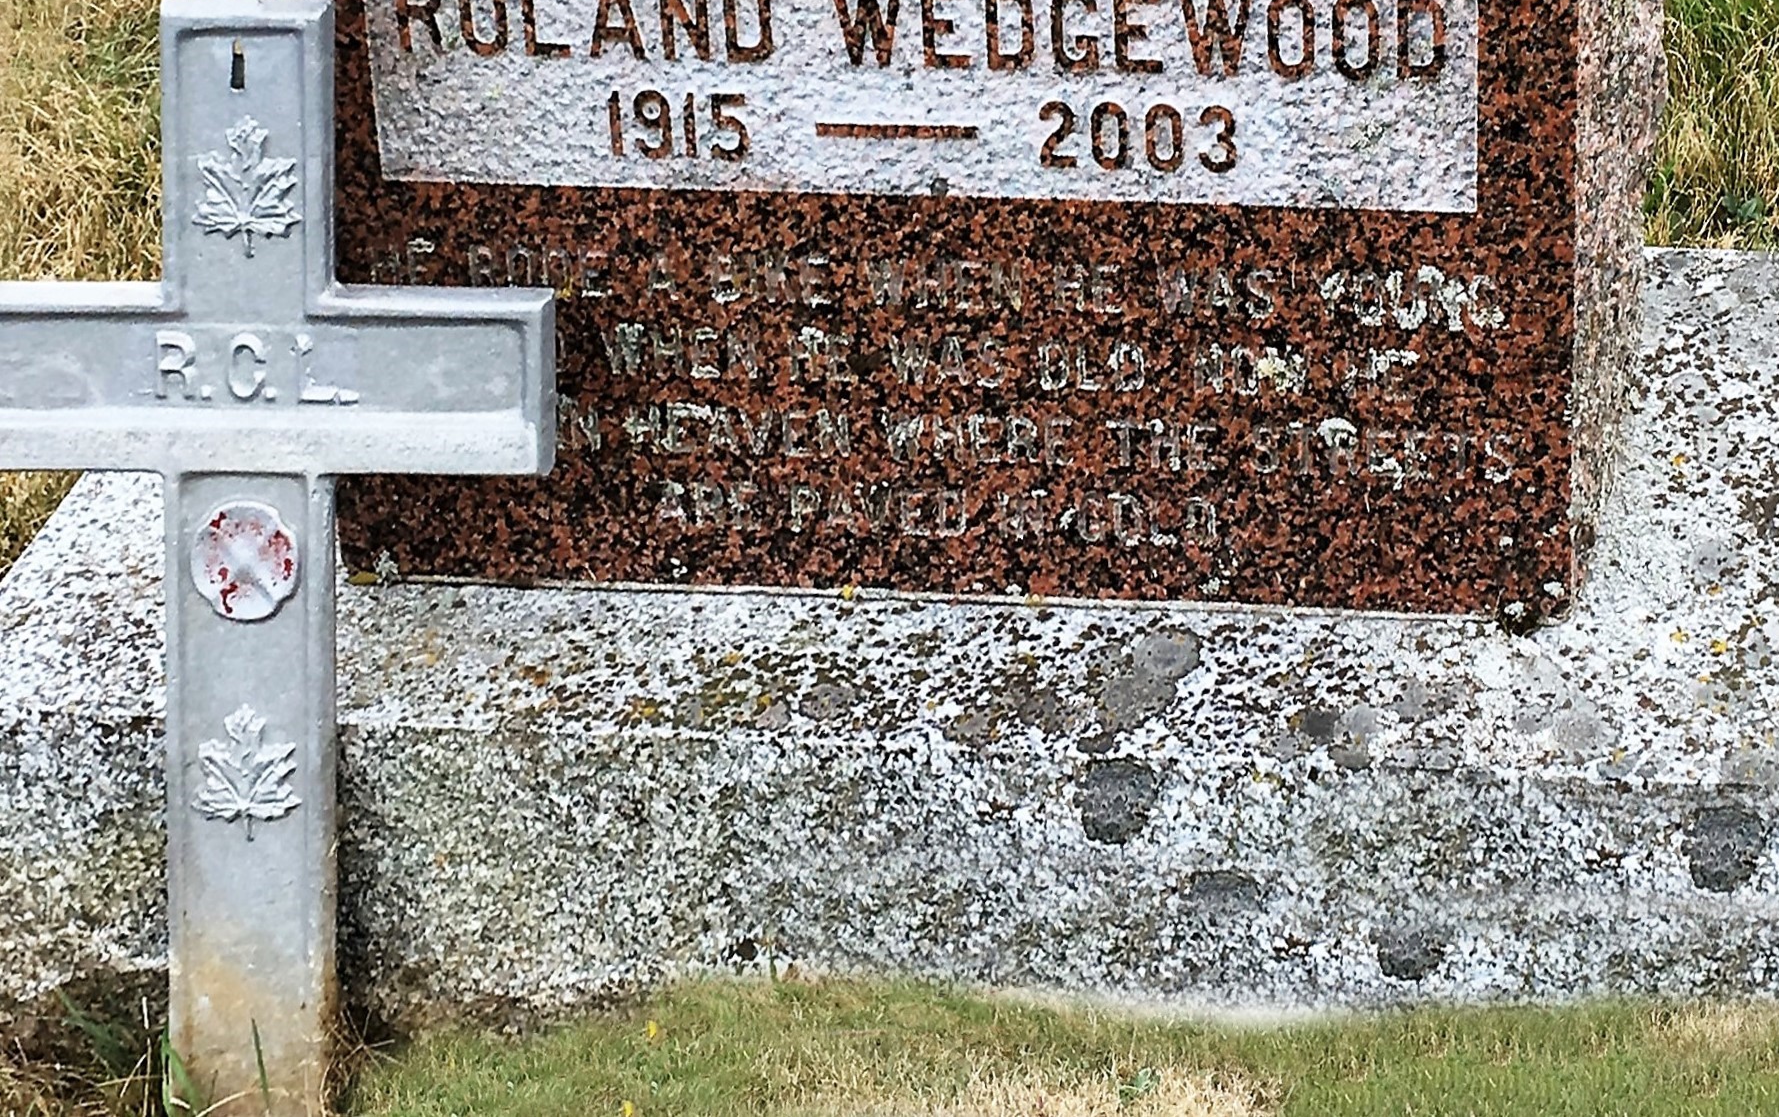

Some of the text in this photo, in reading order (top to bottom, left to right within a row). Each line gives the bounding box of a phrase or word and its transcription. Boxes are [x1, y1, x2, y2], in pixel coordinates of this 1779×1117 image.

[607, 88, 751, 163] 1915
[1038, 100, 1239, 175] 2003
[1052, 262, 1125, 315] HE
[1156, 265, 1276, 321] WAS
[1318, 264, 1506, 332] YOUNG
[600, 322, 760, 381] WHEN
[888, 336, 1008, 391] WAS
[1036, 340, 1149, 394] OLD
[624, 401, 852, 459] HEAVEN
[881, 410, 1076, 468] WHERE
[1105, 416, 1226, 473] THE
[1246, 416, 1516, 486] STREETS
[655, 477, 763, 532] ARE
[788, 481, 969, 539] PAVED
[1072, 491, 1219, 547] GOLD
